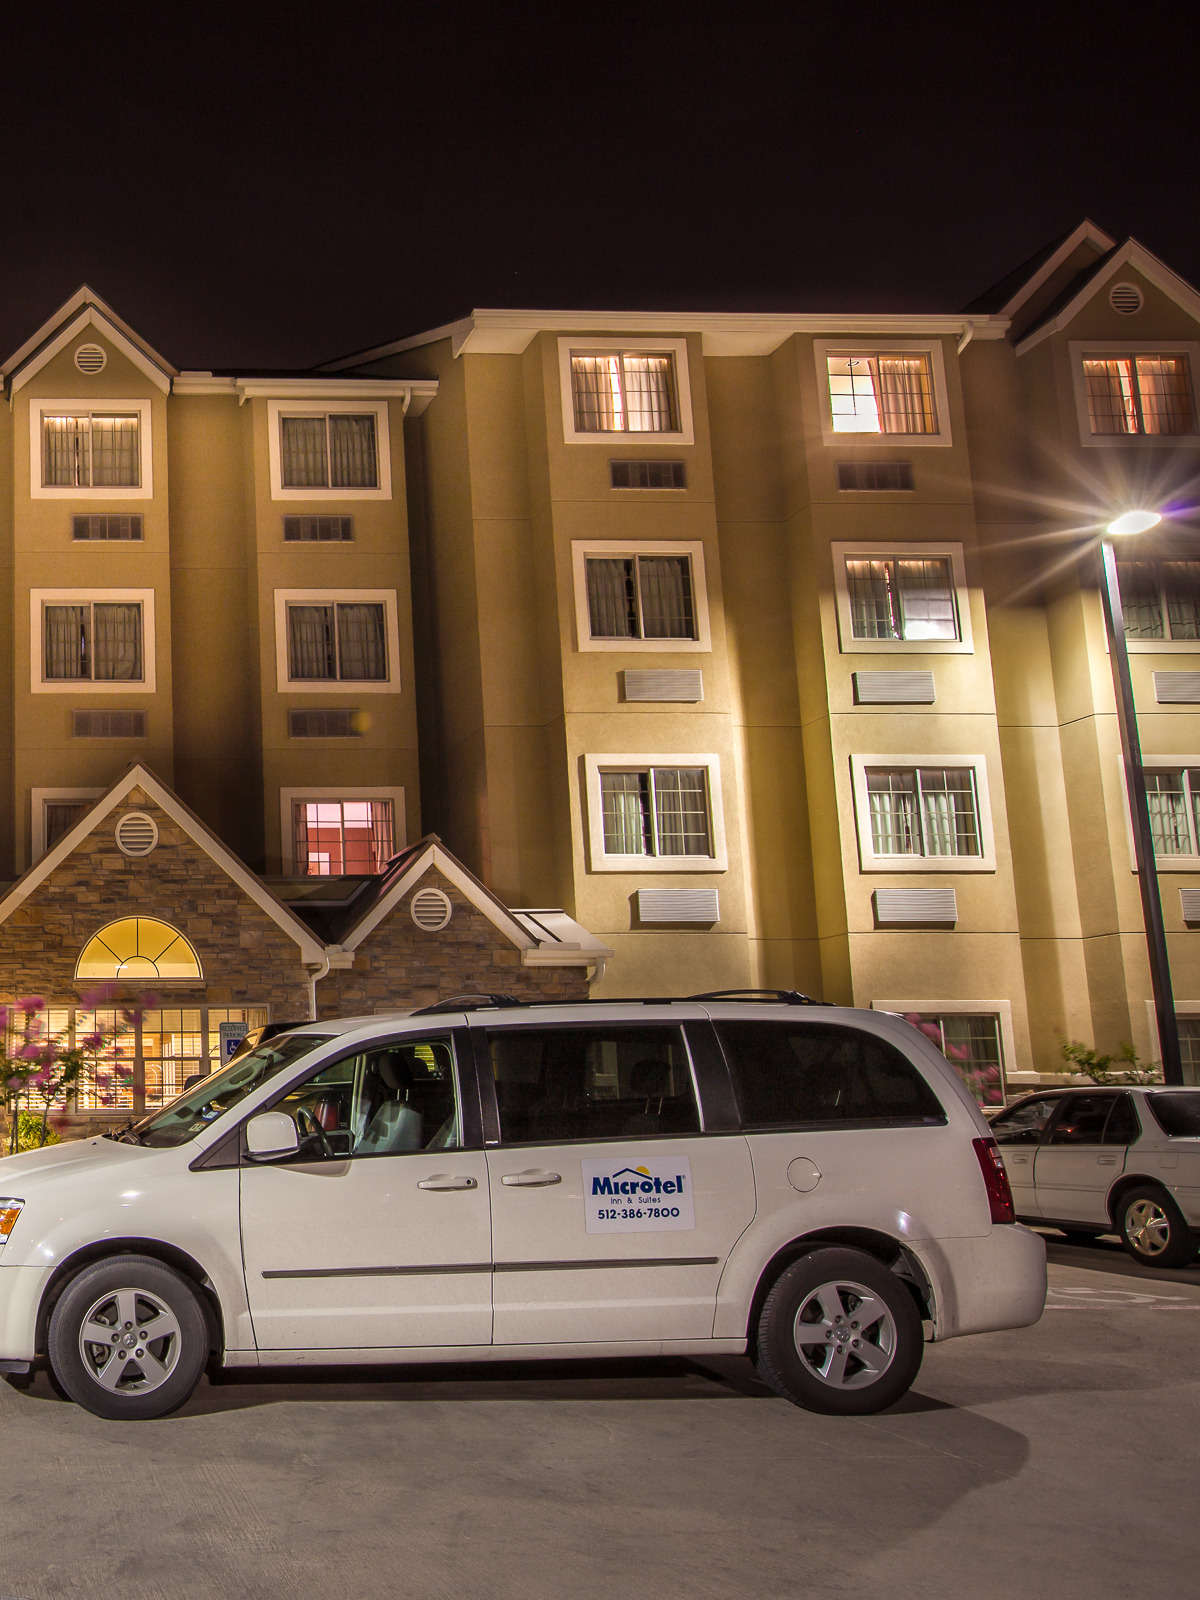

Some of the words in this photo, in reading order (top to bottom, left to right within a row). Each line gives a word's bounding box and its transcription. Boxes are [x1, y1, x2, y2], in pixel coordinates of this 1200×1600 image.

[591, 1175, 684, 1195] Microtel
[638, 1196, 661, 1204] Suites
[598, 1207, 680, 1219] 512-386-7800
